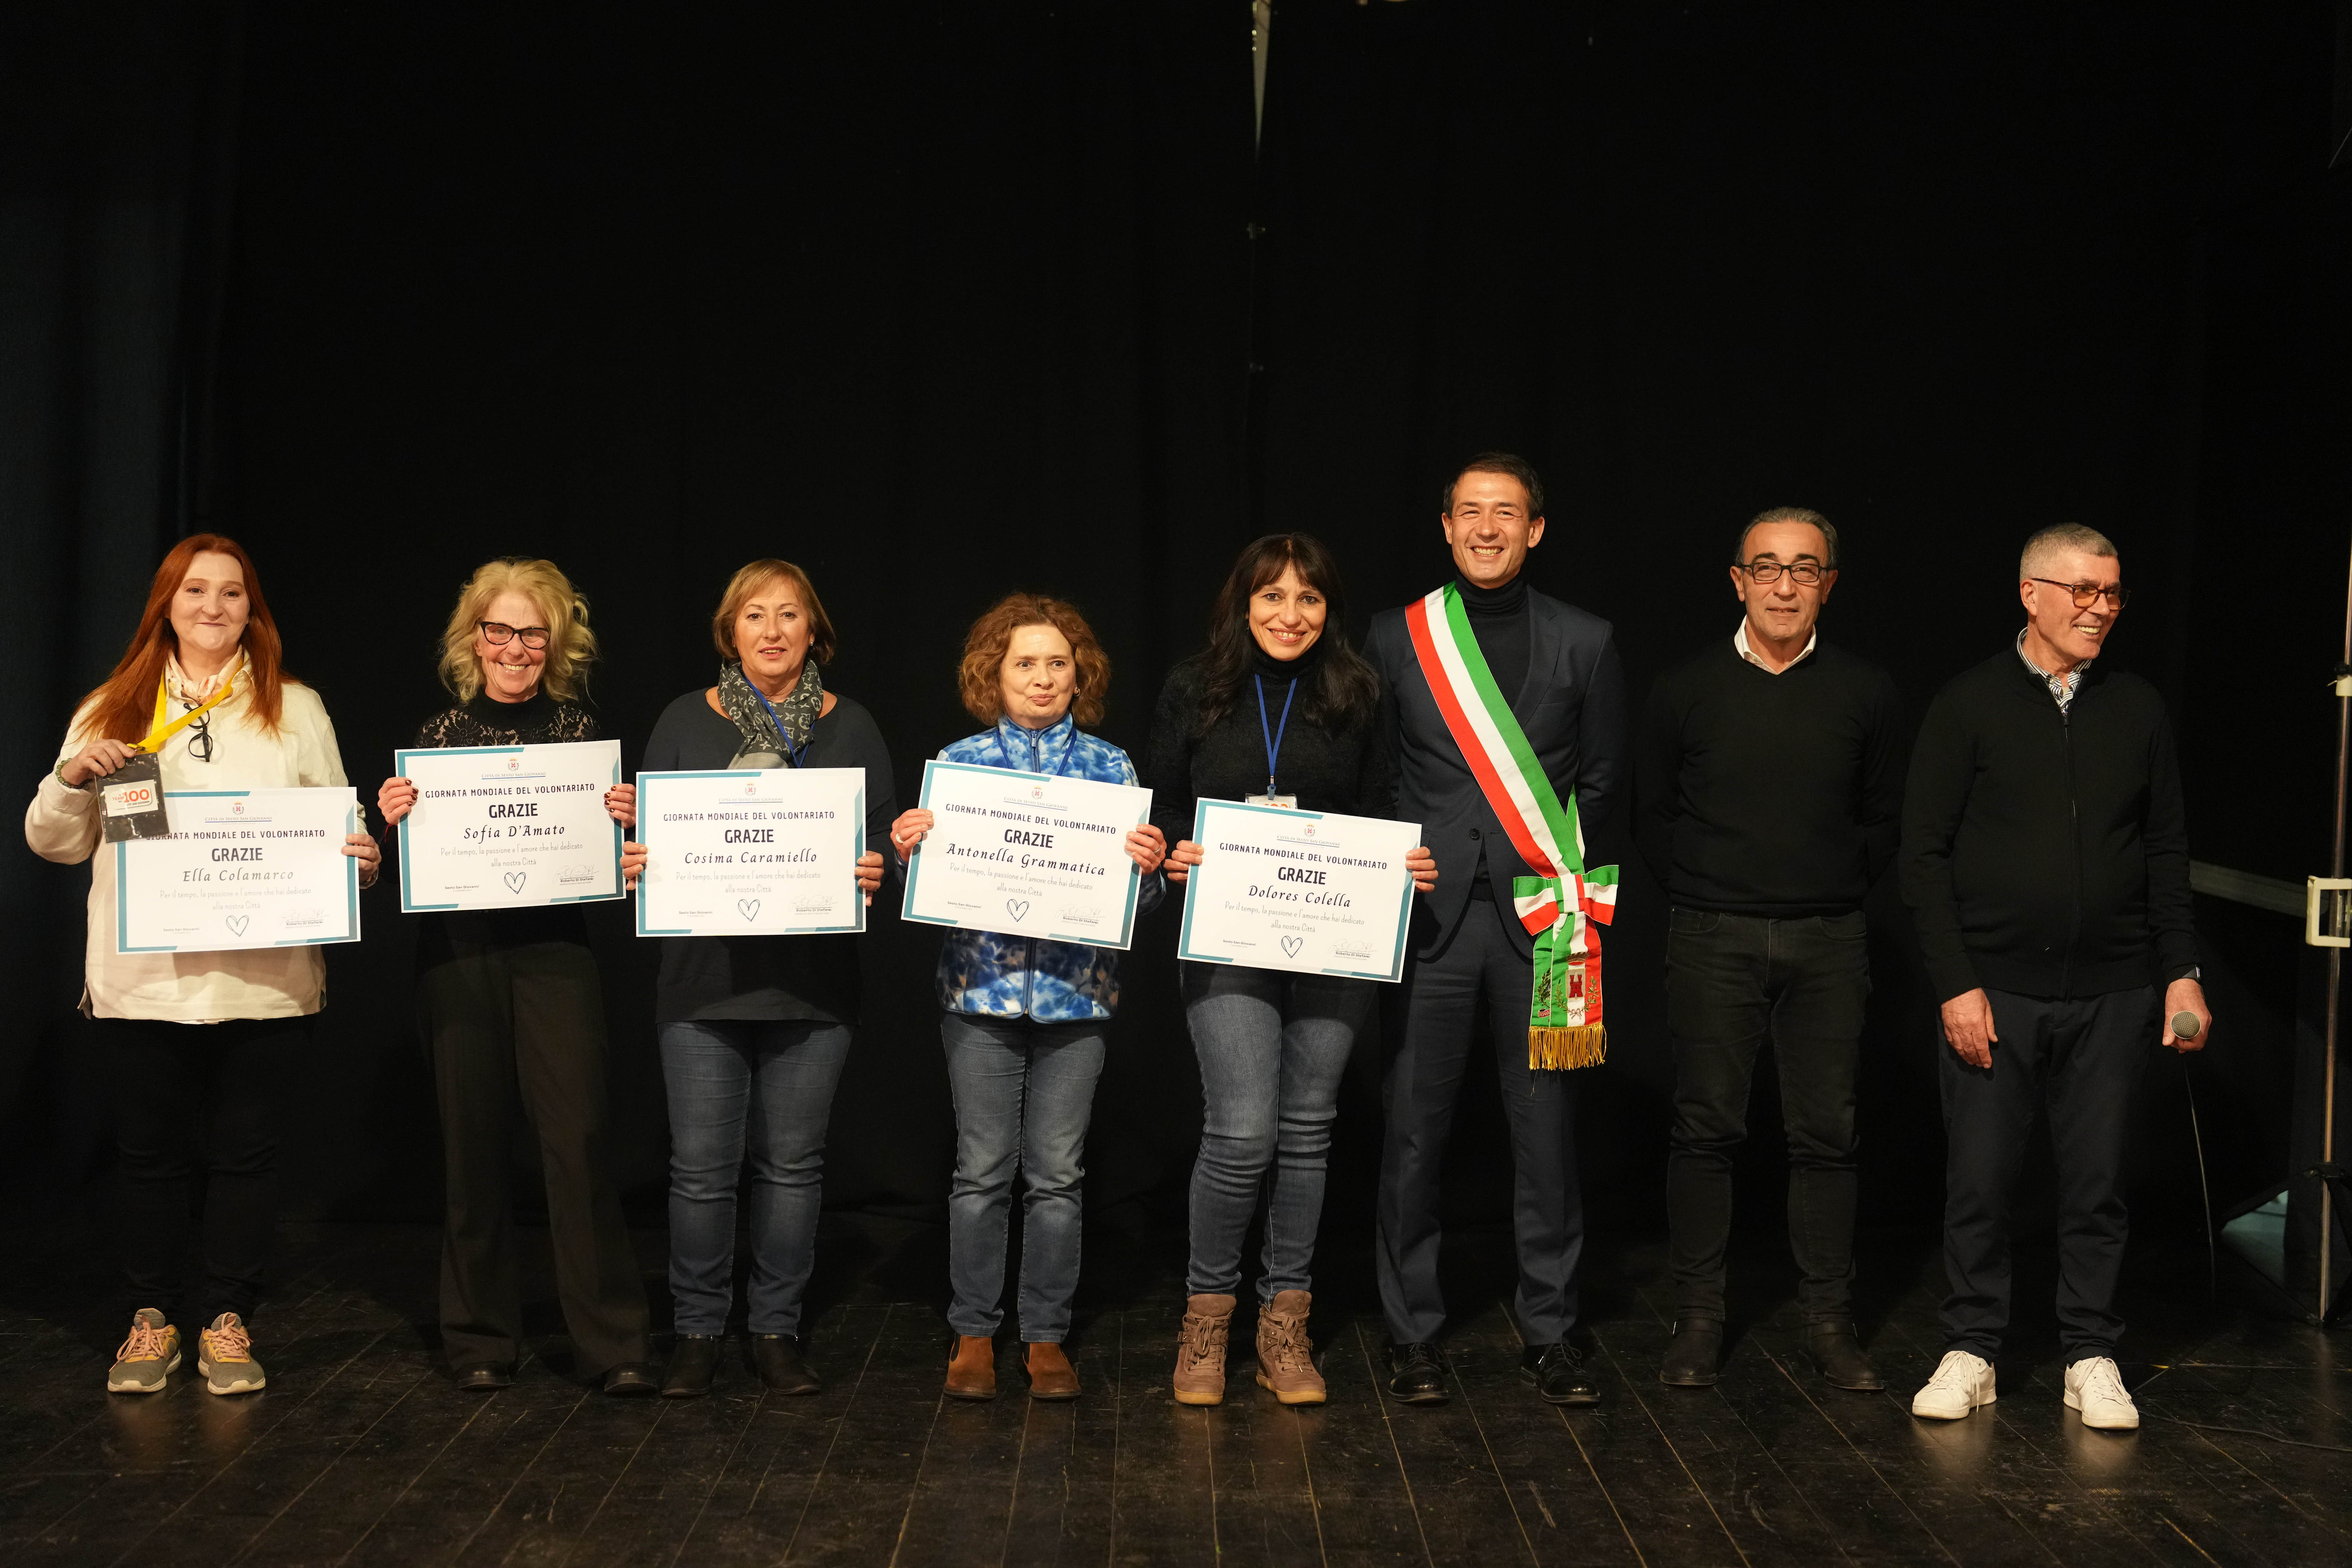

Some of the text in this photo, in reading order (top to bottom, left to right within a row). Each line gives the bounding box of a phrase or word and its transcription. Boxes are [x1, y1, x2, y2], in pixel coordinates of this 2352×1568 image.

[122, 789, 149, 803] 100
[425, 789, 467, 798] GIORNATA
[470, 787, 512, 796] MONDIALE
[534, 783, 594, 793] VOLONTARIATO
[488, 802, 538, 818] GRAZIE
[663, 813, 704, 821] GIORNATA
[771, 811, 834, 819] VOLONTARIATO
[945, 803, 1116, 834] GIORNATA MONDIALE DEL VOLONTARIATO
[260, 829, 325, 838] VOLONTARIATO
[464, 824, 564, 844] Sofia D'Amato
[724, 829, 774, 843] GRAZIE
[1004, 828, 1054, 848] GRAZIE
[211, 847, 263, 862] GRAZIE
[441, 847, 451, 856] Per
[452, 847, 456, 855] il
[479, 845, 484, 854] la
[485, 847, 510, 856] passione
[539, 842, 549, 851] che
[550, 841, 559, 851] hai
[560, 841, 583, 850] dedicato
[684, 848, 816, 864] Cosima Caramiello
[1219, 842, 1387, 870] GIORNATA MONDIALE DEL VOLONTARIATO
[491, 858, 501, 867] alla
[522, 857, 536, 865] Città
[946, 843, 1104, 875] Antonella Grammatica
[182, 867, 293, 882] Ella Colamarco
[676, 871, 686, 880] Per
[687, 871, 691, 880] il
[714, 871, 719, 880] la
[720, 873, 745, 882] passione
[774, 869, 784, 879] che
[786, 869, 795, 879] hai
[796, 869, 821, 879] dedicato
[950, 862, 960, 871] Per
[961, 863, 965, 872] il
[966, 867, 985, 876] tempo,
[987, 867, 992, 876] la
[1047, 876, 1057, 885] che
[1058, 877, 1067, 887] hai
[1068, 878, 1092, 890] dedicato
[1277, 866, 1326, 885] GRAZIE
[160, 890, 171, 898] Per
[172, 889, 176, 898] il
[200, 888, 205, 897] la
[207, 890, 234, 899] passione
[263, 886, 274, 896] che
[276, 886, 285, 895] hai
[286, 886, 311, 894] dedicato
[725, 883, 735, 893] alla
[756, 884, 771, 893] Città
[996, 882, 1007, 891] alla
[1027, 886, 1042, 896] Città
[1248, 885, 1350, 907] Dolores Colella
[212, 901, 224, 910] alla
[245, 900, 260, 909] Città
[1225, 901, 1235, 910] Per
[1236, 902, 1240, 910] il
[1241, 905, 1260, 914] tempo,
[1262, 904, 1267, 914] la
[1320, 911, 1330, 921] che
[1331, 913, 1340, 922] hai
[1341, 914, 1364, 925] dedicato
[1271, 919, 1281, 928] alla
[1301, 923, 1315, 933] Città
